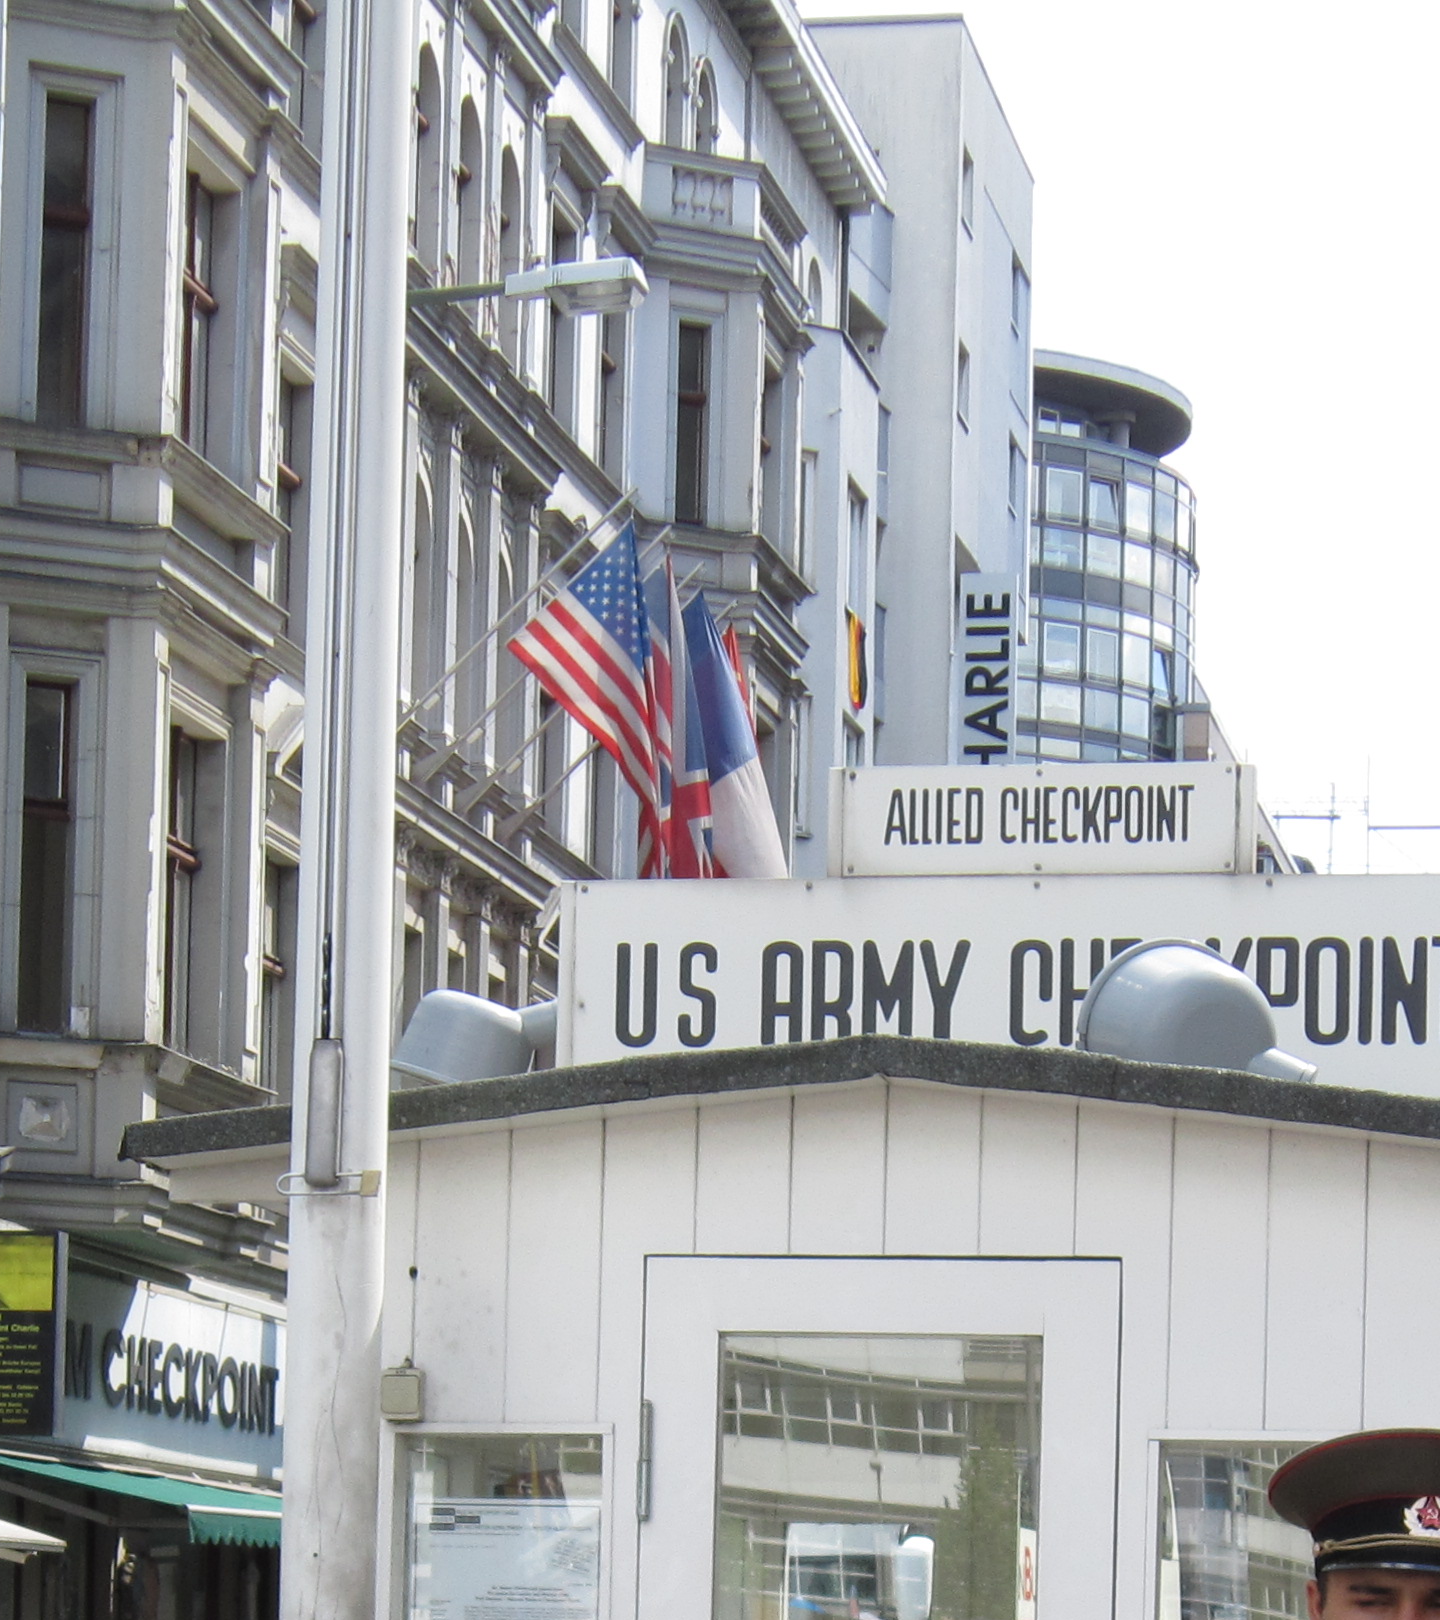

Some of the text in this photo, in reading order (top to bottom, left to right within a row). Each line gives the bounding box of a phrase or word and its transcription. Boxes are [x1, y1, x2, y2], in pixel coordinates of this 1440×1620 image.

[963, 592, 1010, 765] HARLIE
[883, 783, 1195, 846] ALLIED CHECKPOINT
[760, 938, 971, 1046] ARMY
[101, 1328, 280, 1437] CHECKPOINT
